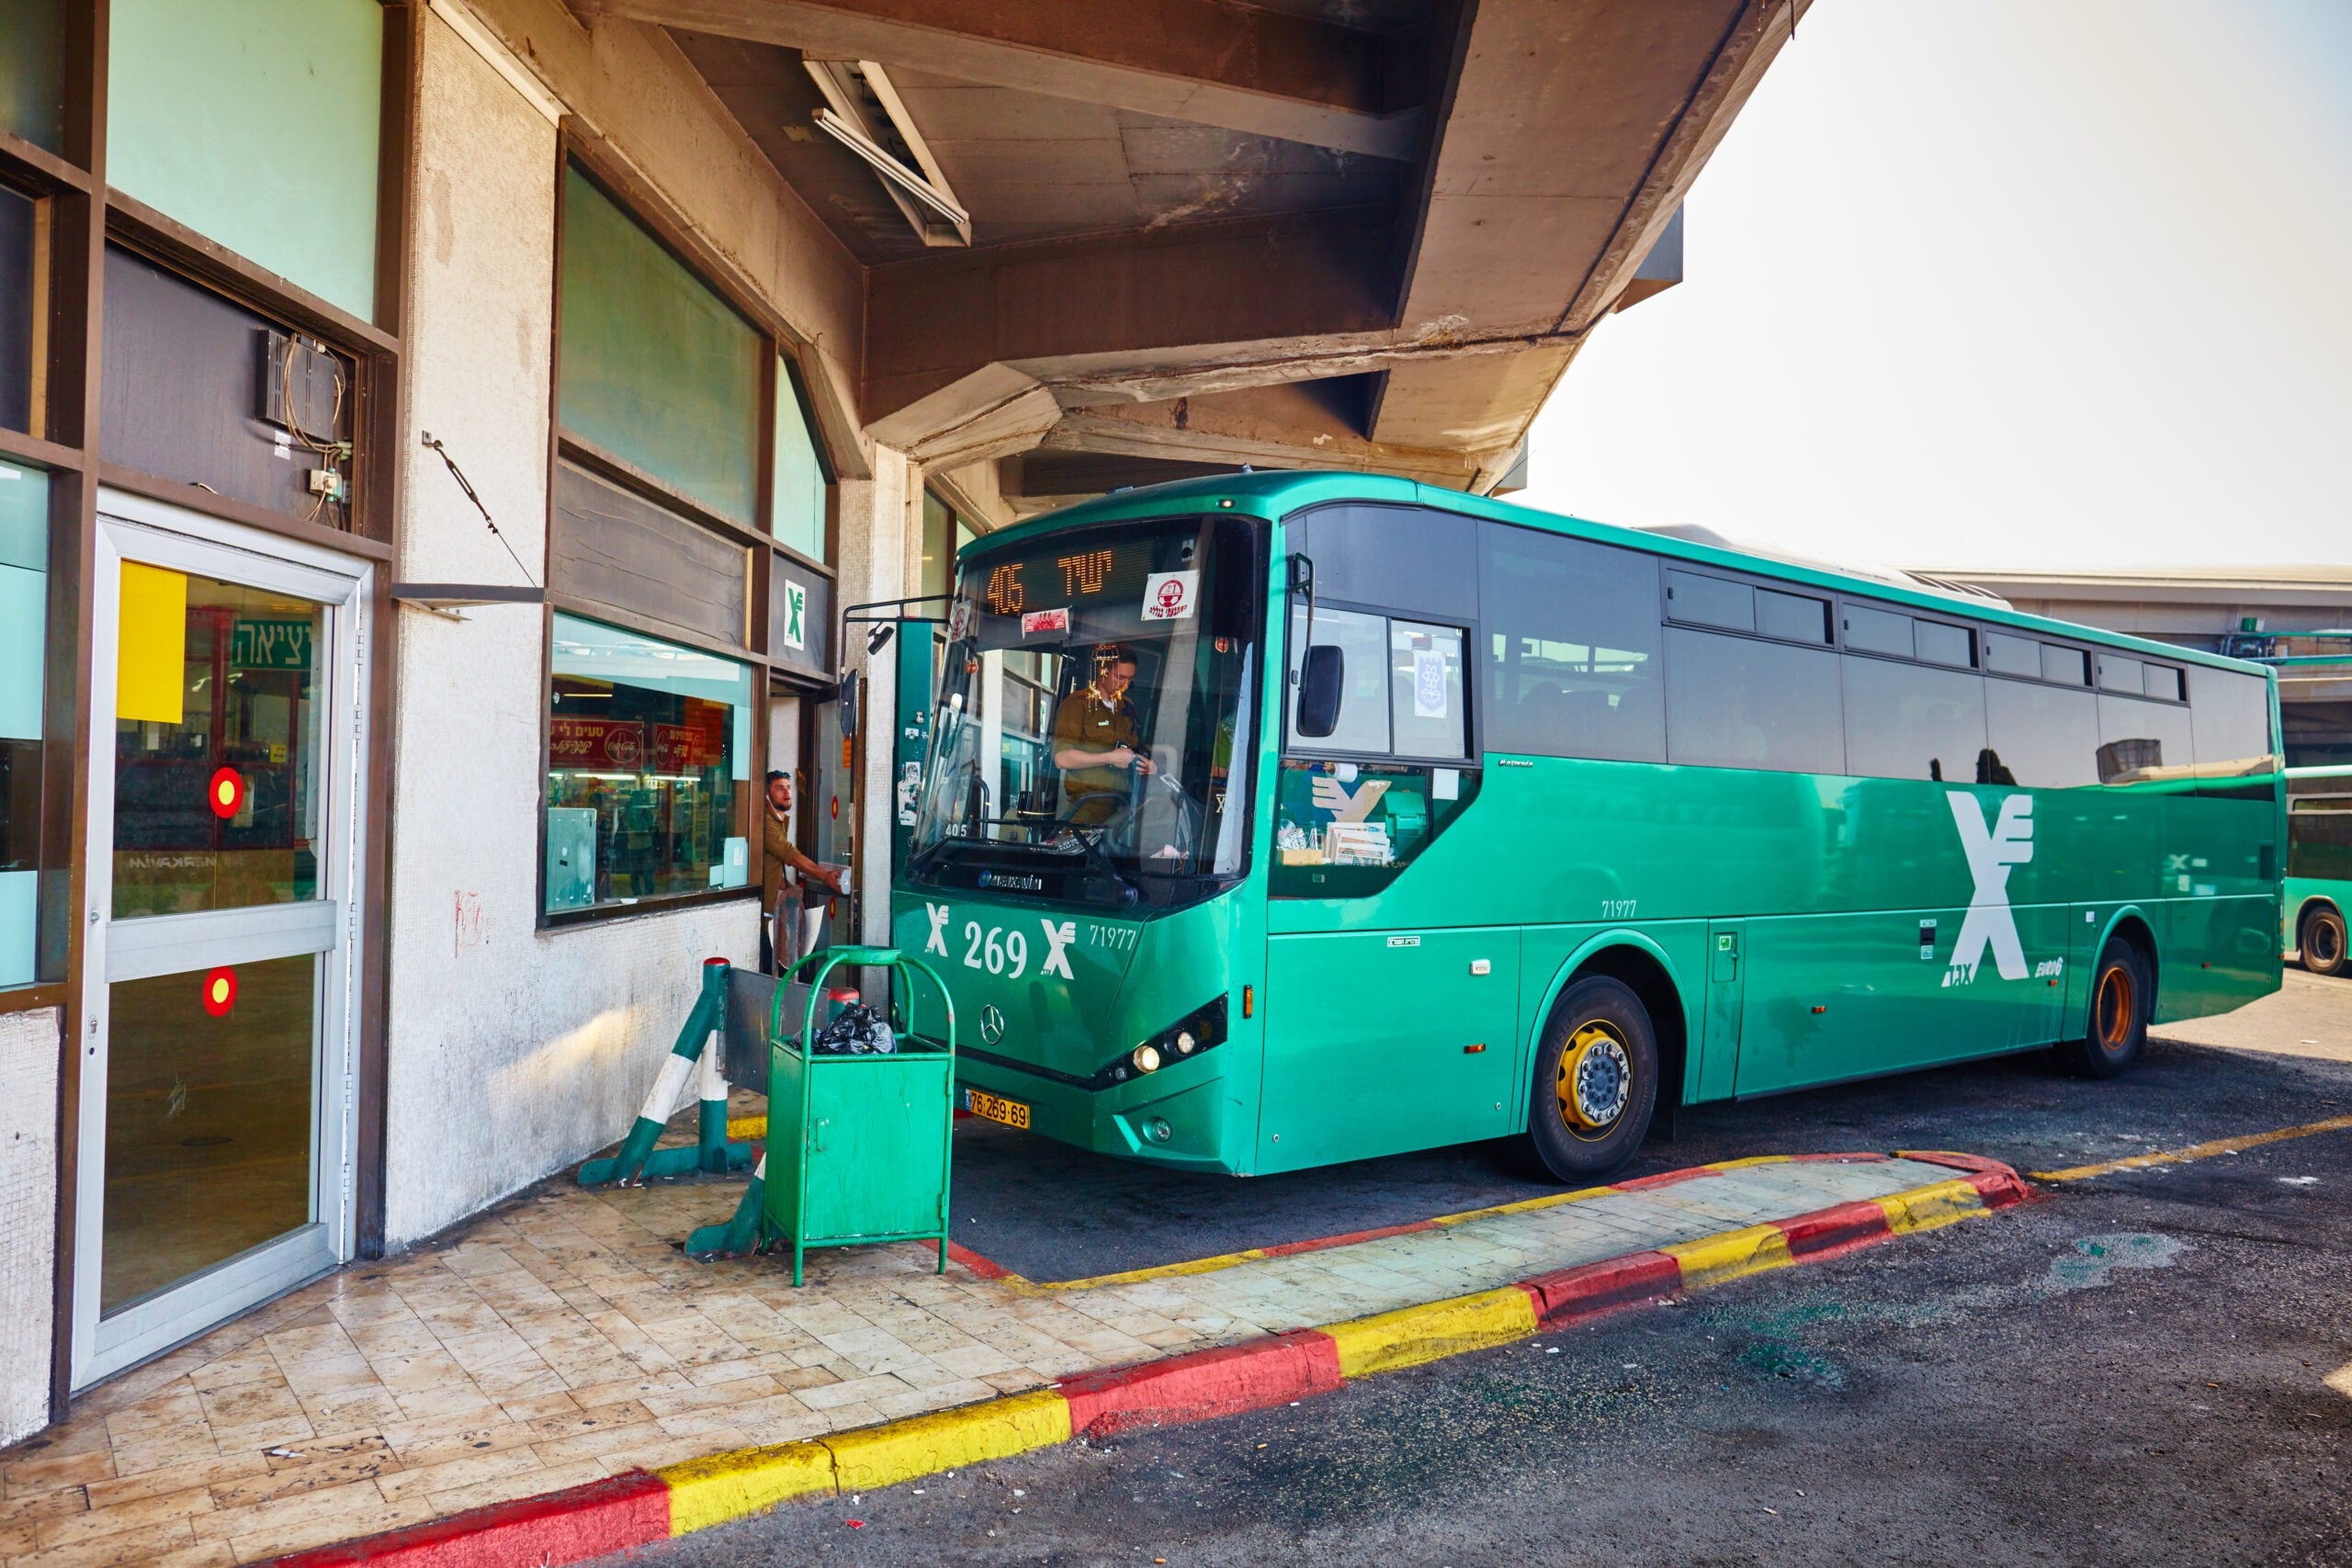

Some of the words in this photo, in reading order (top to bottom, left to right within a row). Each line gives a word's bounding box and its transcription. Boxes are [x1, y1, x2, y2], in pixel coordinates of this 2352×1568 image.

[987, 562, 1023, 615] 405
[1057, 550, 1112, 596] ישיר
[236, 624, 311, 664] יציאה
[945, 824, 967, 837] 405
[1601, 899, 1636, 919] 71977
[964, 920, 1028, 979] 269
[1090, 924, 1136, 951] 71977
